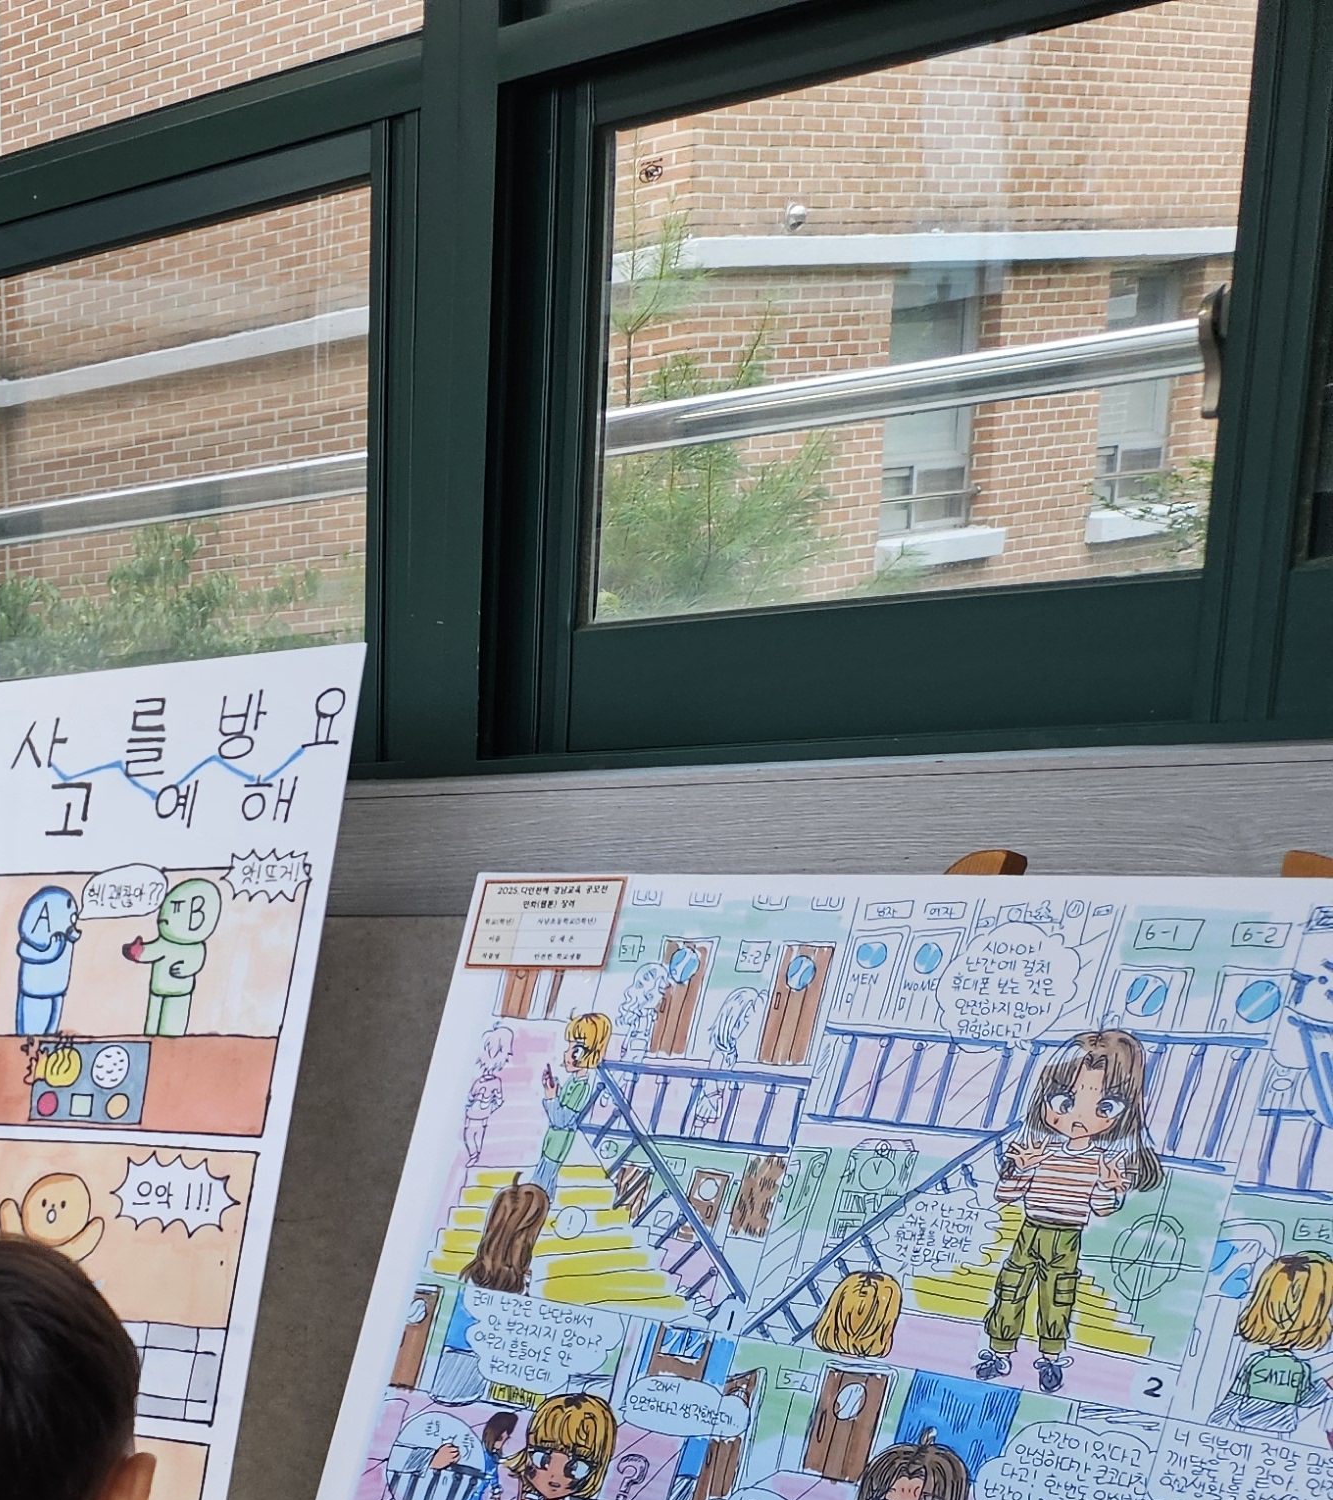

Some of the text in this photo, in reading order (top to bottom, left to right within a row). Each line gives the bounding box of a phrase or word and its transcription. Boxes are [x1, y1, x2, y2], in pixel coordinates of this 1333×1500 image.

[553, 885, 581, 894] 경남교육
[585, 885, 608, 894] 공모전
[188, 896, 205, 931] B
[561, 900, 576, 909] 장려
[929, 906, 956, 917] 여자
[31, 901, 51, 934] A
[1145, 925, 1179, 942] 6-1
[1242, 926, 1278, 943] 6-2
[965, 957, 1017, 974] 난간에
[849, 973, 880, 985] MEN
[951, 972, 1056, 996] 휴대폰 보는 것은
[954, 998, 1011, 1016] 안전하지
[957, 1019, 1032, 1041] 위험하다고!
[132, 1181, 173, 1209] 으악
[941, 1203, 954, 1218] 난
[931, 1219, 973, 1235] 시간에
[500, 1296, 532, 1317] 난간은
[539, 1304, 594, 1328] 단단해서
[488, 1314, 502, 1330] 안
[506, 1319, 557, 1341] 부러지지
[474, 1331, 506, 1350] 아무리
[558, 1351, 573, 1367] 안
[647, 1379, 680, 1394] 그래서
[782, 1373, 809, 1391] 5-6
[1143, 1377, 1163, 1398] 2
[1037, 1425, 1142, 1467] 난간이 있다고
[1174, 1428, 1301, 1472] 너 덕분에 정말
[1014, 1443, 1091, 1482] 안심하다간
